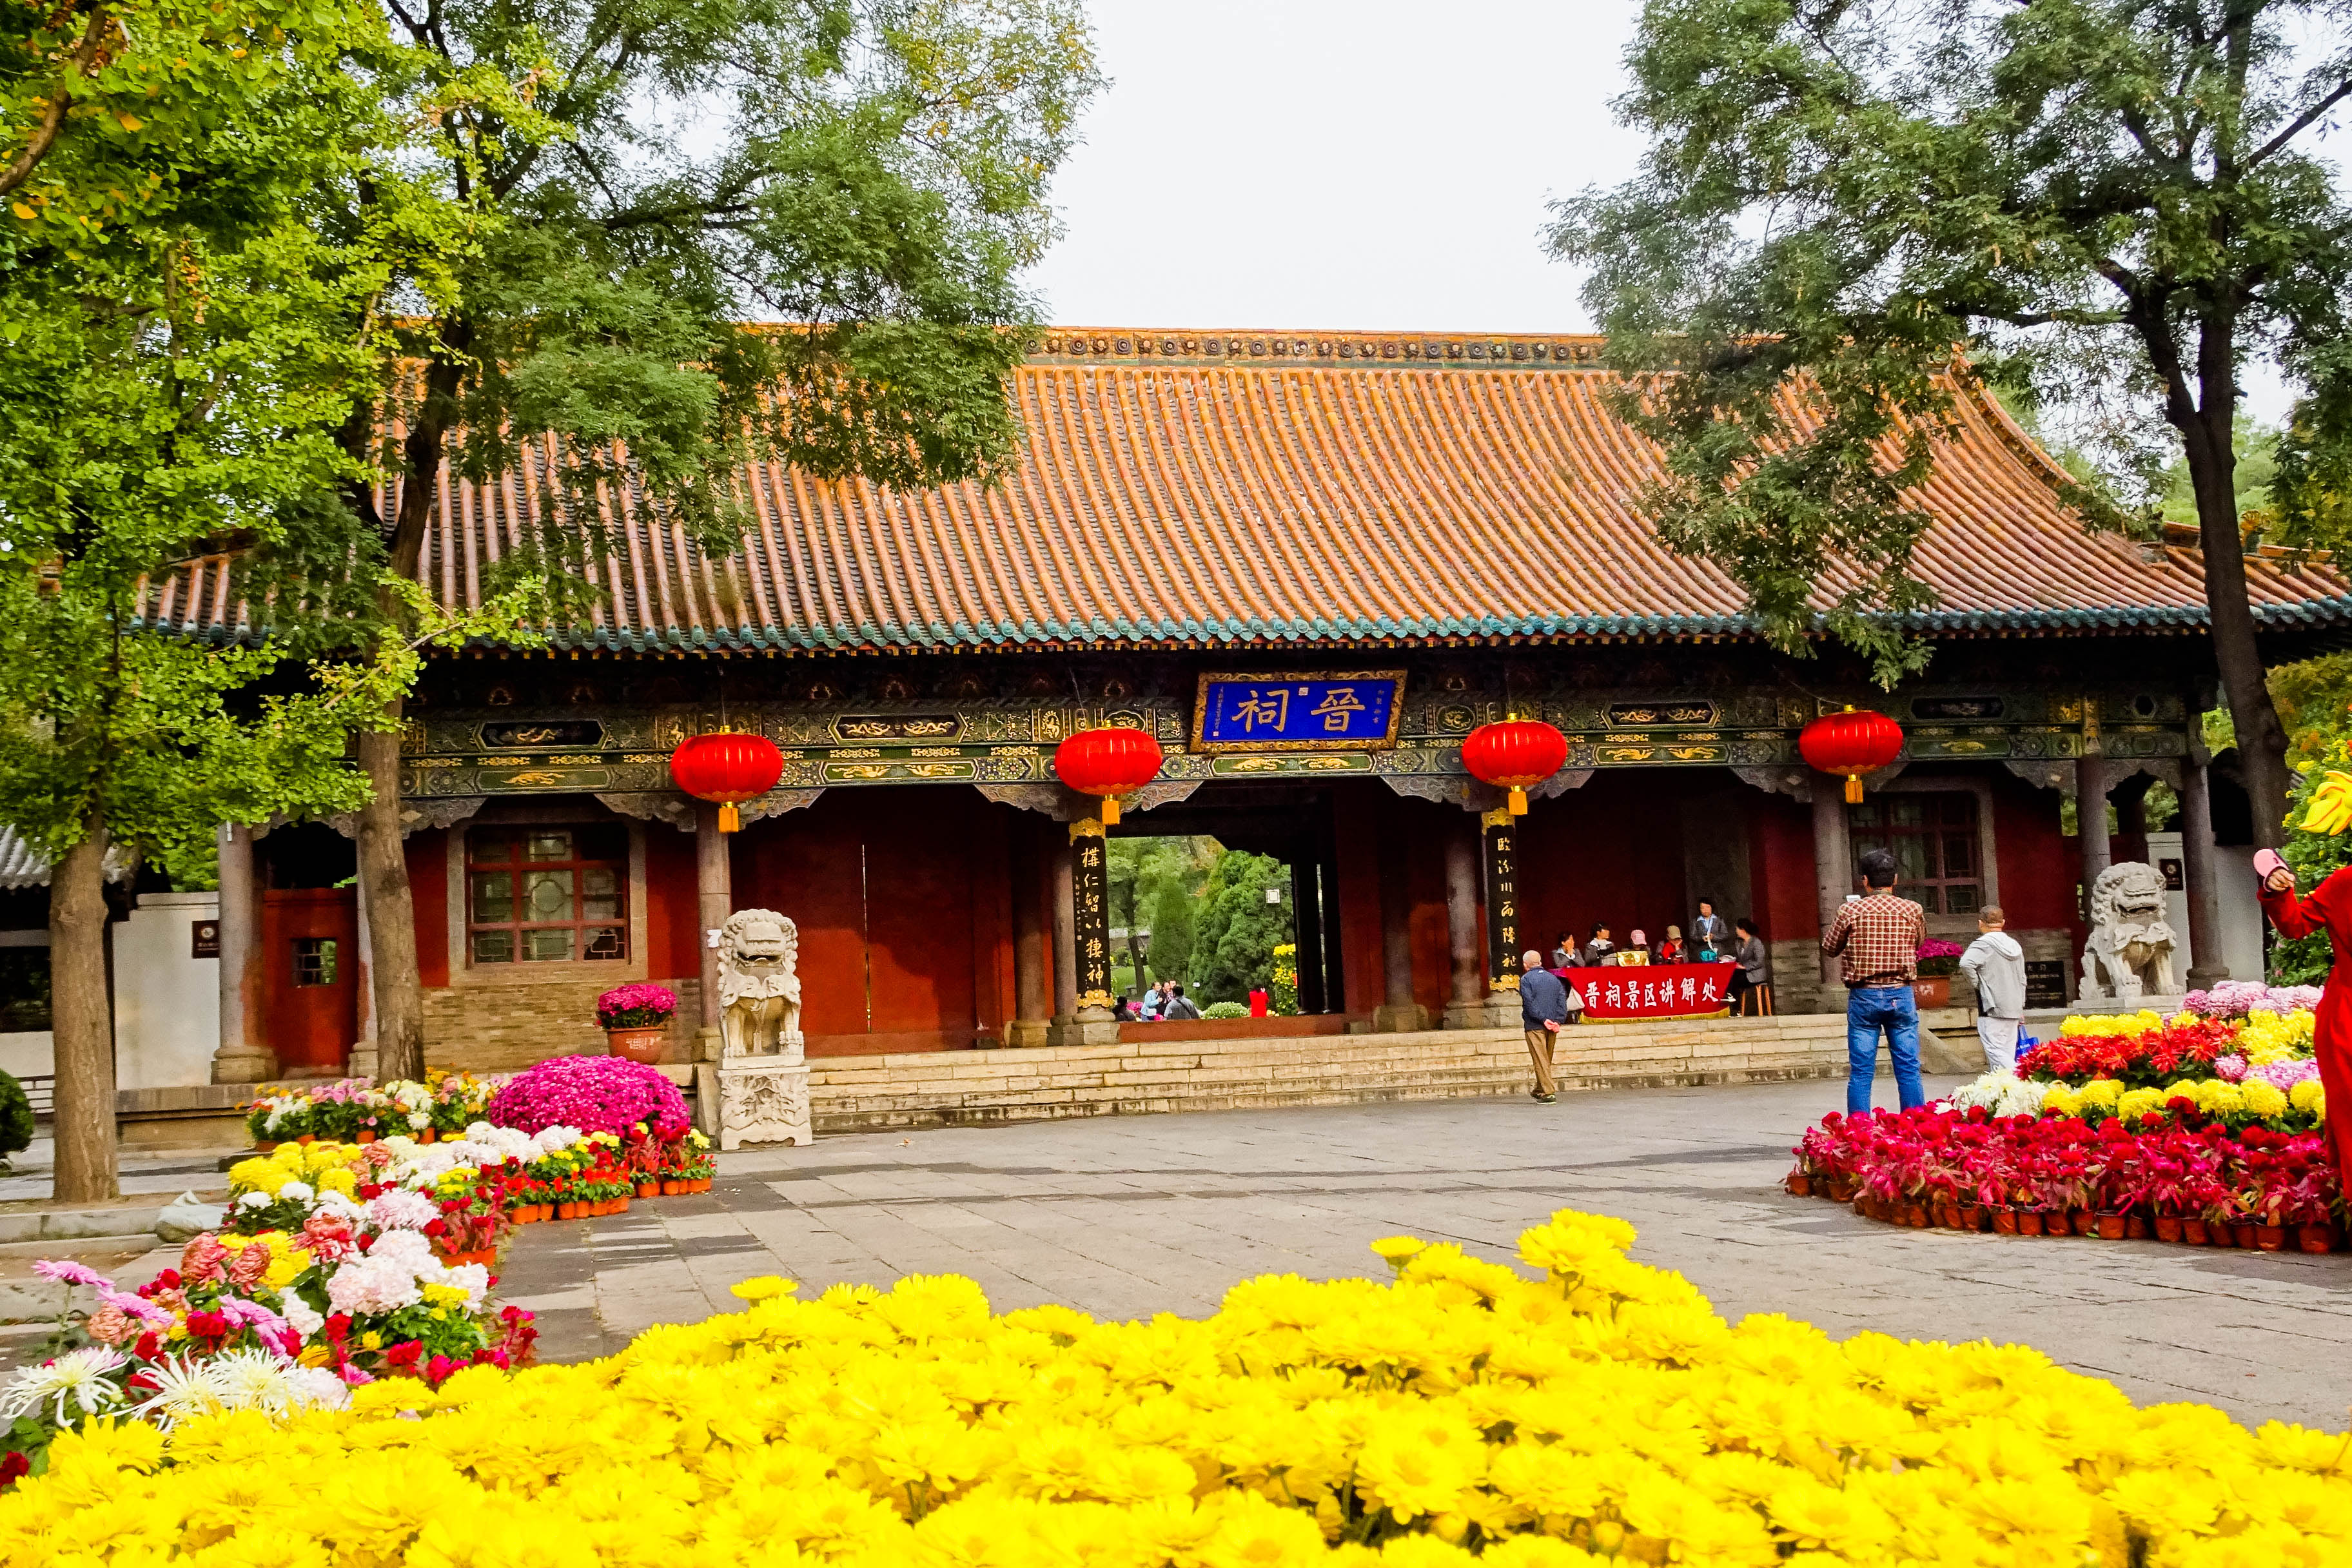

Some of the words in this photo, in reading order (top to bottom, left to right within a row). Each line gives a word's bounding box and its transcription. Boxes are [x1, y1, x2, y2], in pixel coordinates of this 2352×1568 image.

[1585, 977, 1719, 1010] 晋祠景区讲解处
